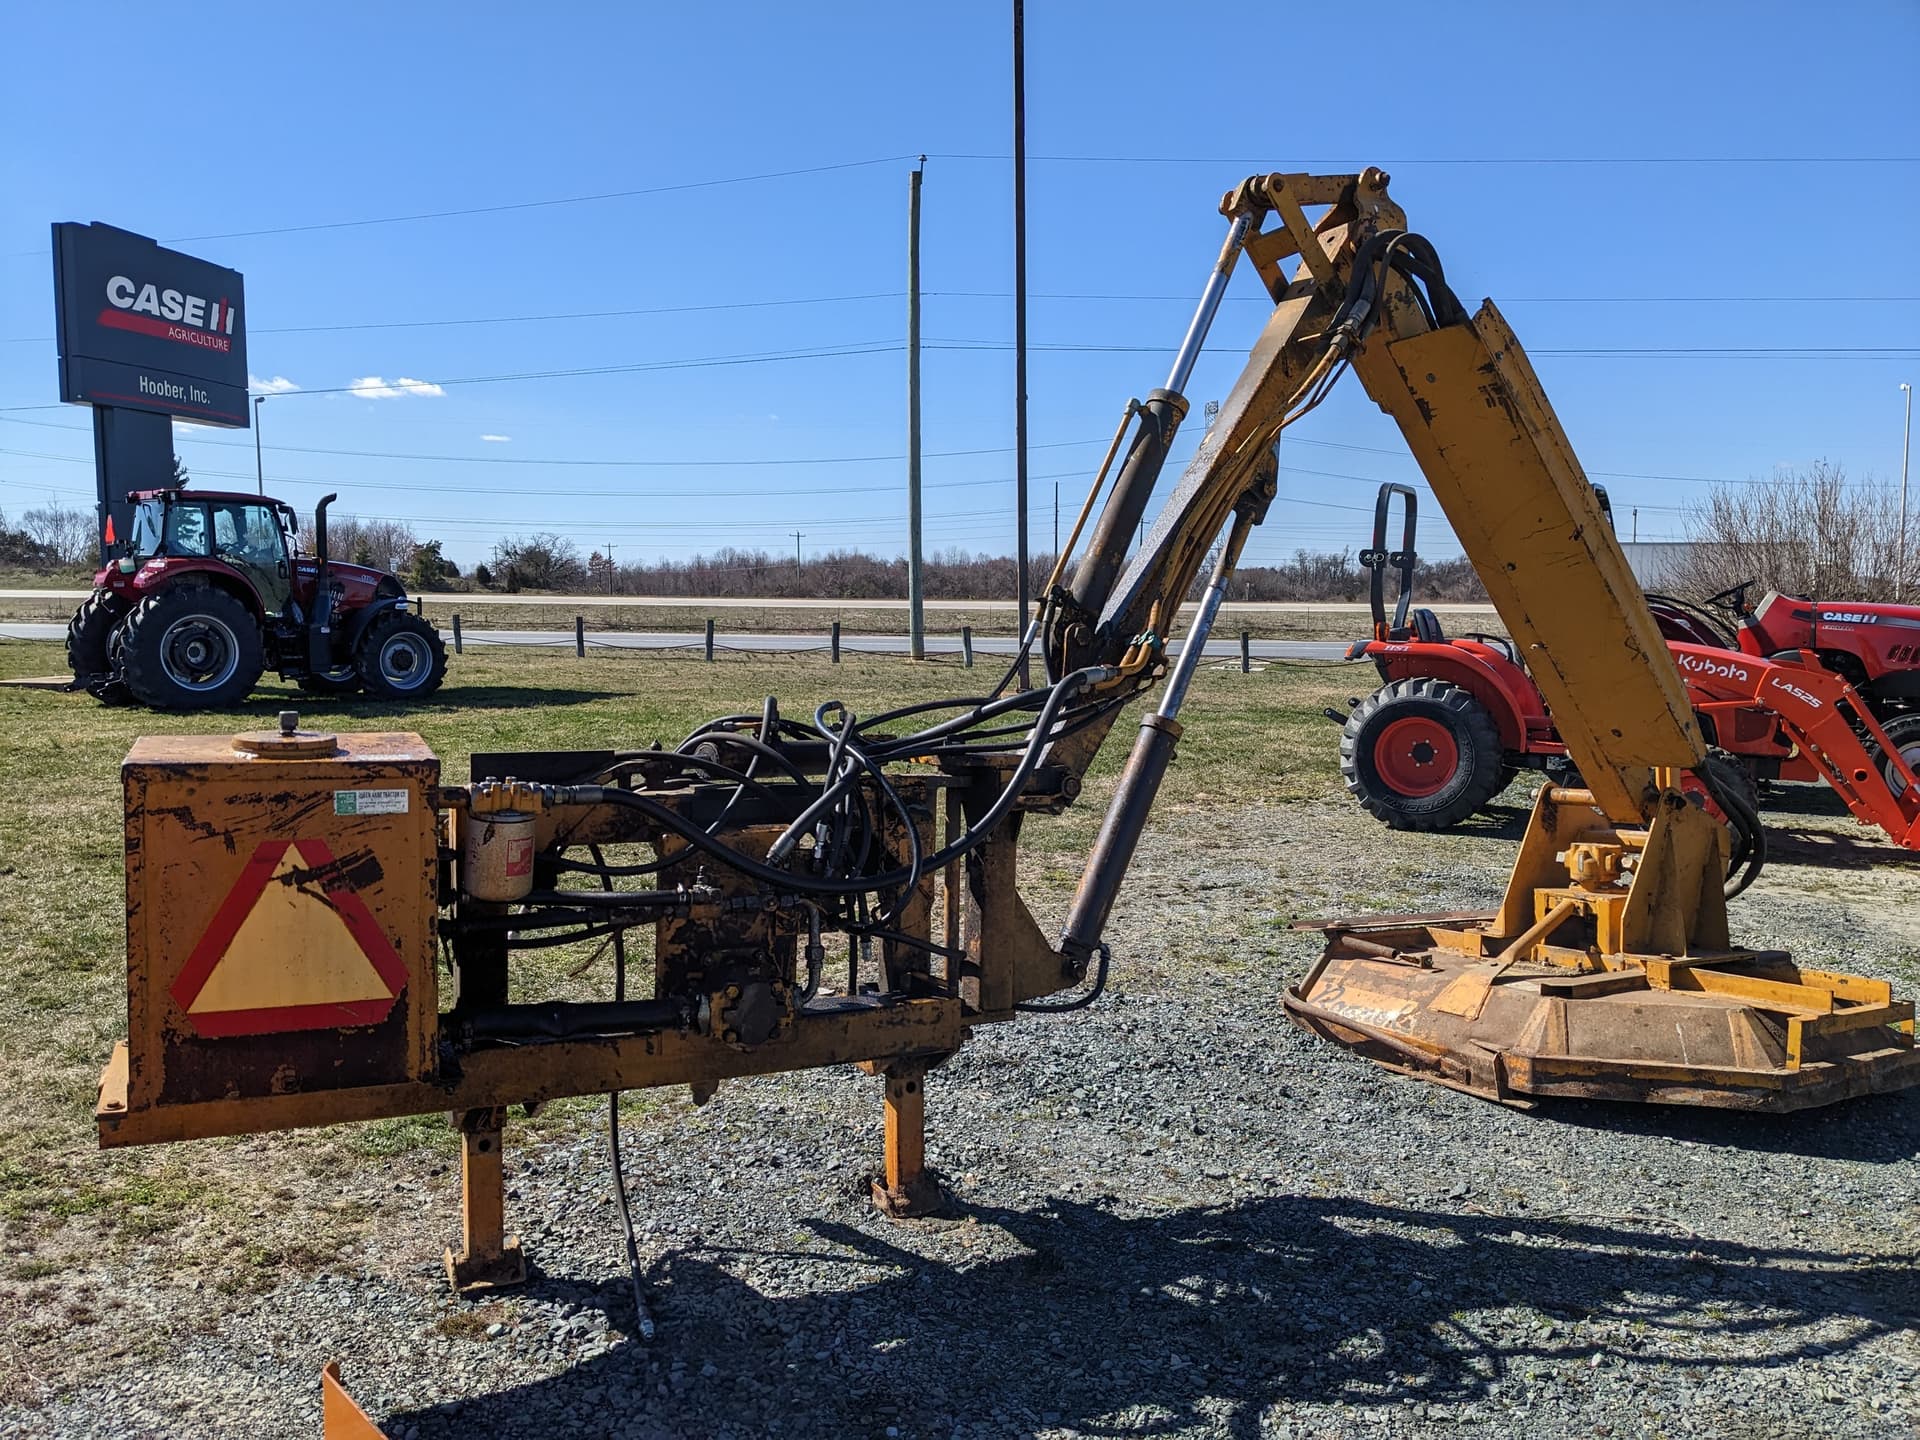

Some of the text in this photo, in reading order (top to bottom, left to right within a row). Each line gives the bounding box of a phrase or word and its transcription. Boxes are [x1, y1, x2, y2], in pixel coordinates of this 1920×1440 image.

[106, 275, 206, 327] CASE
[168, 327, 229, 352] AGRICULTURE
[139, 375, 211, 404] Hoober, Inc.
[1823, 611, 1863, 623] CASE
[1677, 654, 1749, 682] Kubota
[1771, 677, 1824, 708] LA525
